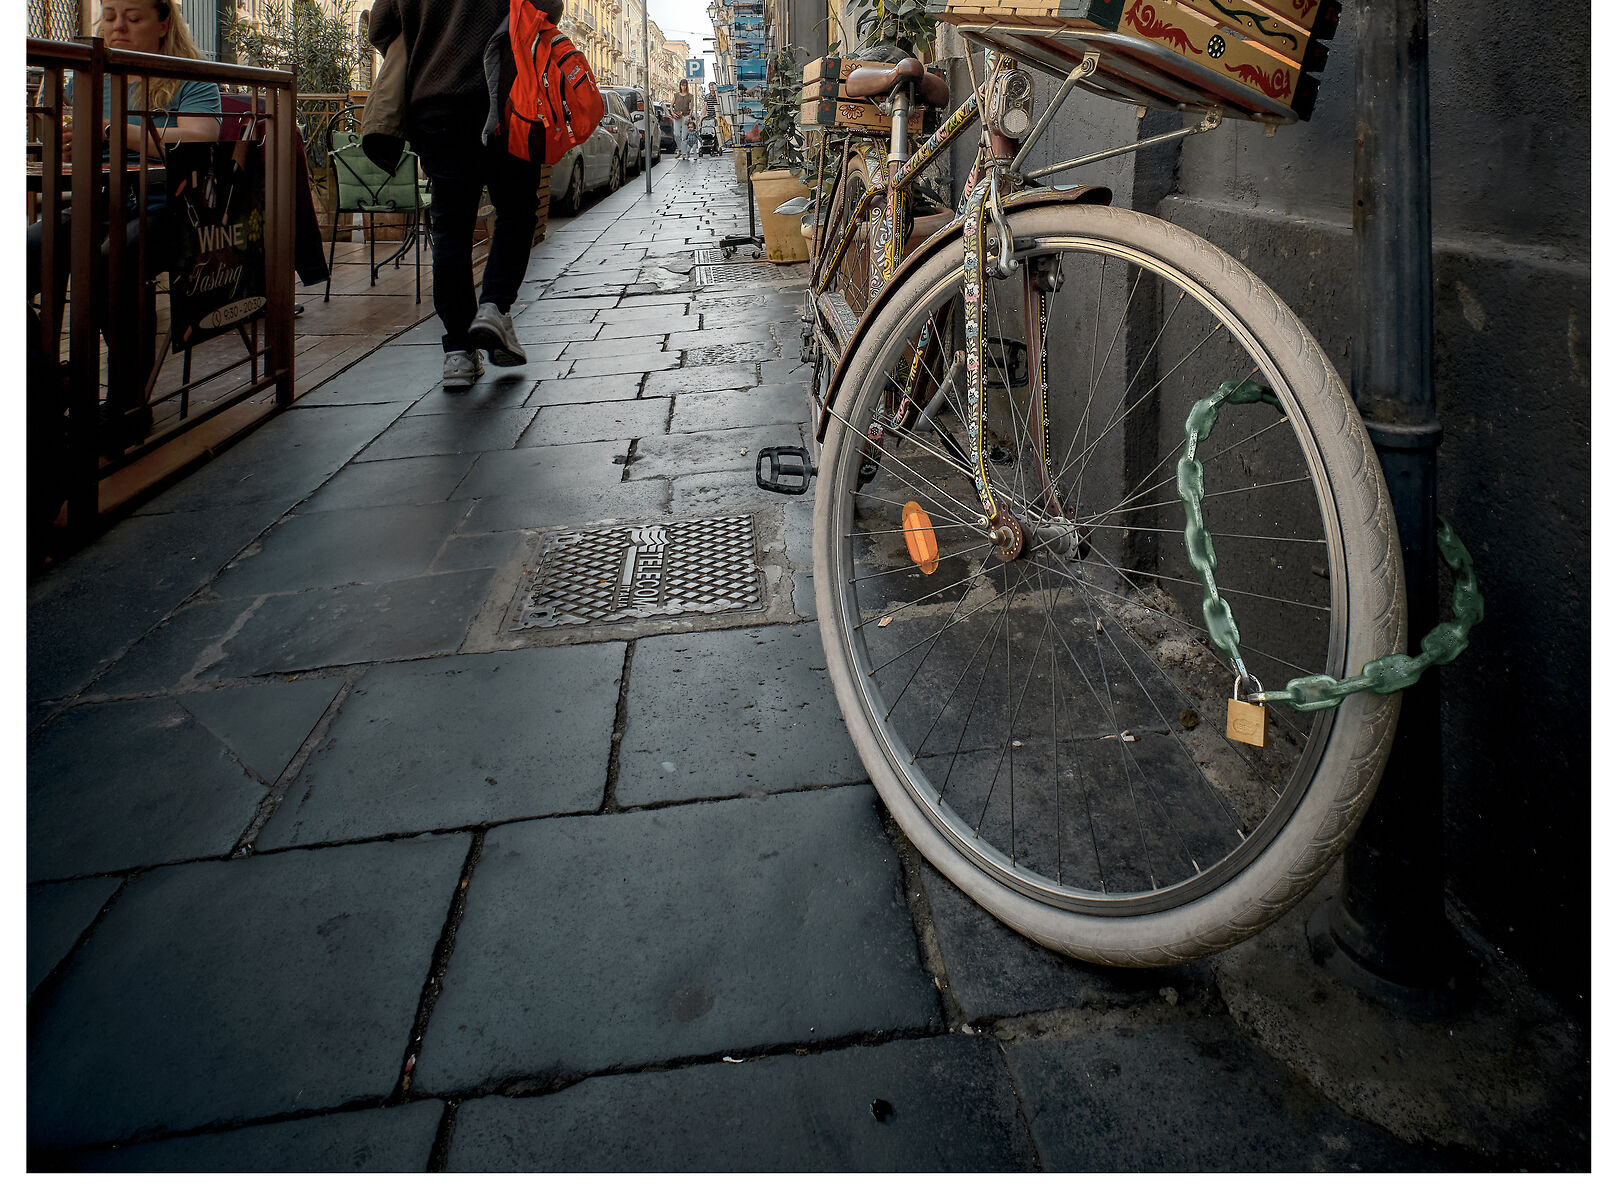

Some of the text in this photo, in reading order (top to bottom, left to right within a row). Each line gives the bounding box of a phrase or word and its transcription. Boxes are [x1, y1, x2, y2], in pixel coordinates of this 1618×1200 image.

[689, 61, 701, 75] P
[197, 223, 244, 254] WINE
[186, 256, 243, 298] Tasting
[632, 552, 664, 609] TELECOM
[617, 585, 631, 608] ITALIA
